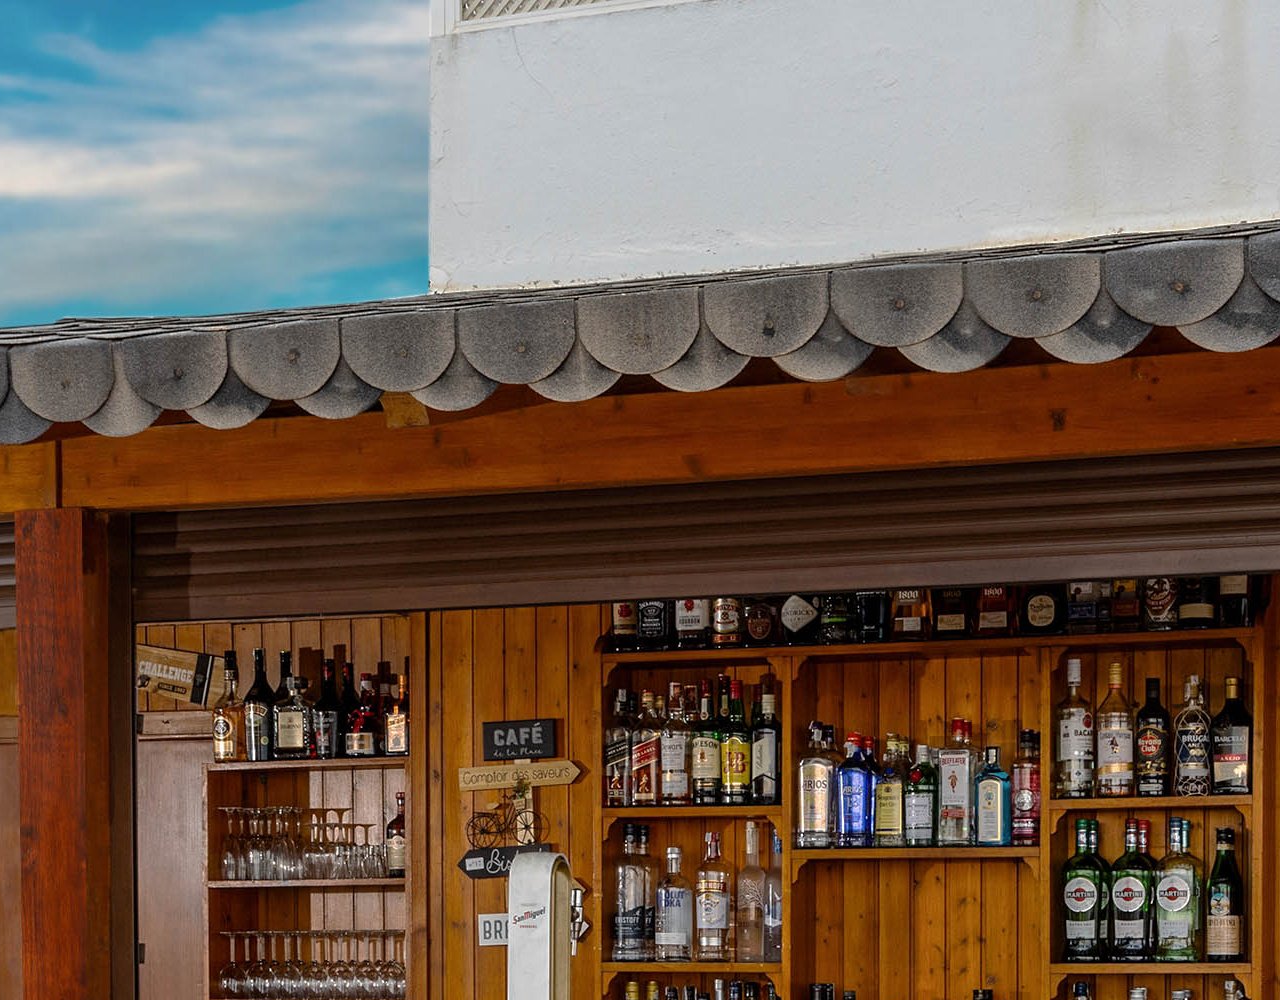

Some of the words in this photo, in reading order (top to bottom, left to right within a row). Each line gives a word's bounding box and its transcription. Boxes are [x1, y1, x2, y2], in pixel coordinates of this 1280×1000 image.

[897, 590, 919, 600] 1800
[983, 587, 1003, 597] 1800
[139, 660, 194, 683] CHALLENGE
[493, 722, 543, 747] CAFÉ
[1141, 745, 1156, 753] Club
[463, 769, 507, 785] Comptoir
[511, 769, 529, 781] des
[532, 766, 571, 780] saveurs
